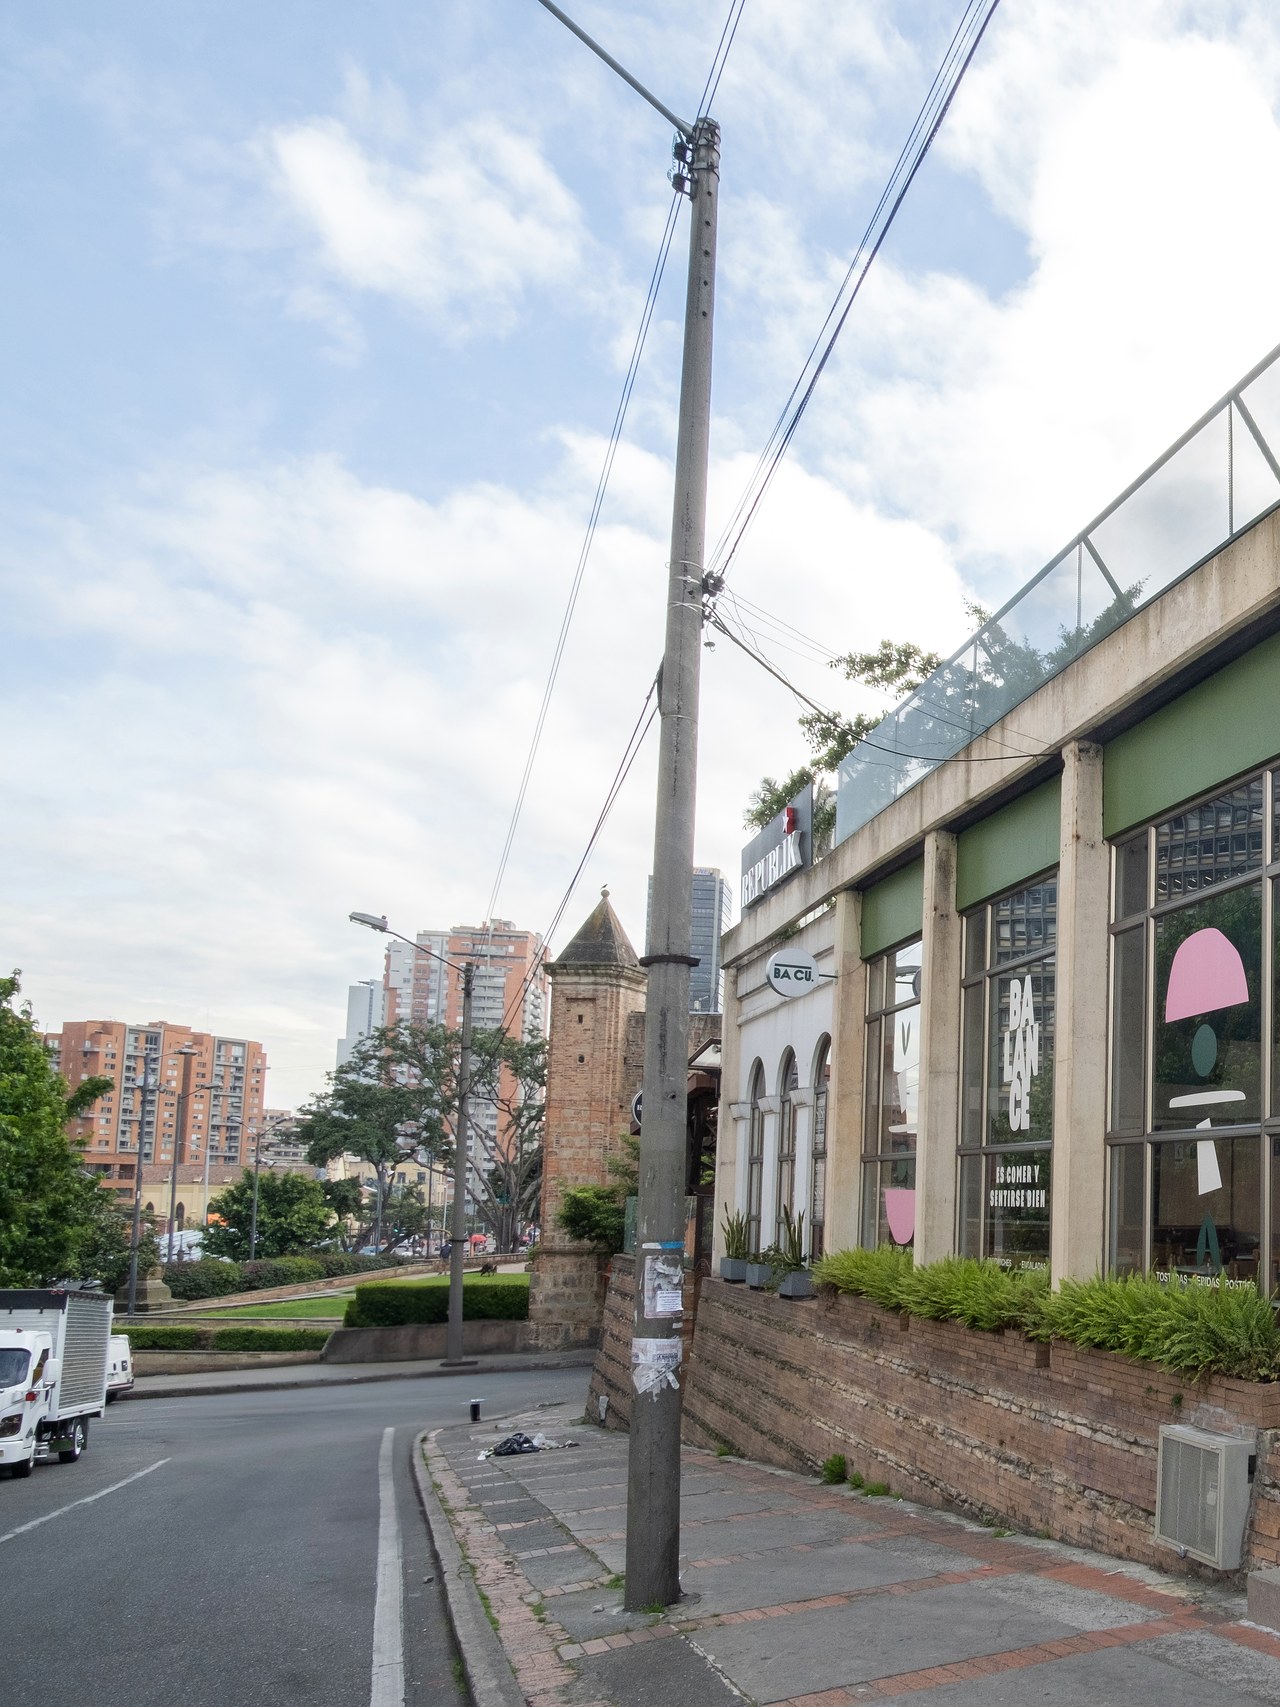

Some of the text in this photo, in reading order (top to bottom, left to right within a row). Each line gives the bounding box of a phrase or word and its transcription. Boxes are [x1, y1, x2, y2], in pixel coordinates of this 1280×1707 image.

[741, 830, 803, 908] REPUBLIK
[773, 967, 791, 980] BA
[996, 1164, 1040, 1183] ES COMER Y
[989, 1189, 1046, 1208] SENTIRSE BIEN
[1156, 1271, 1188, 1285] TOSTDAS
